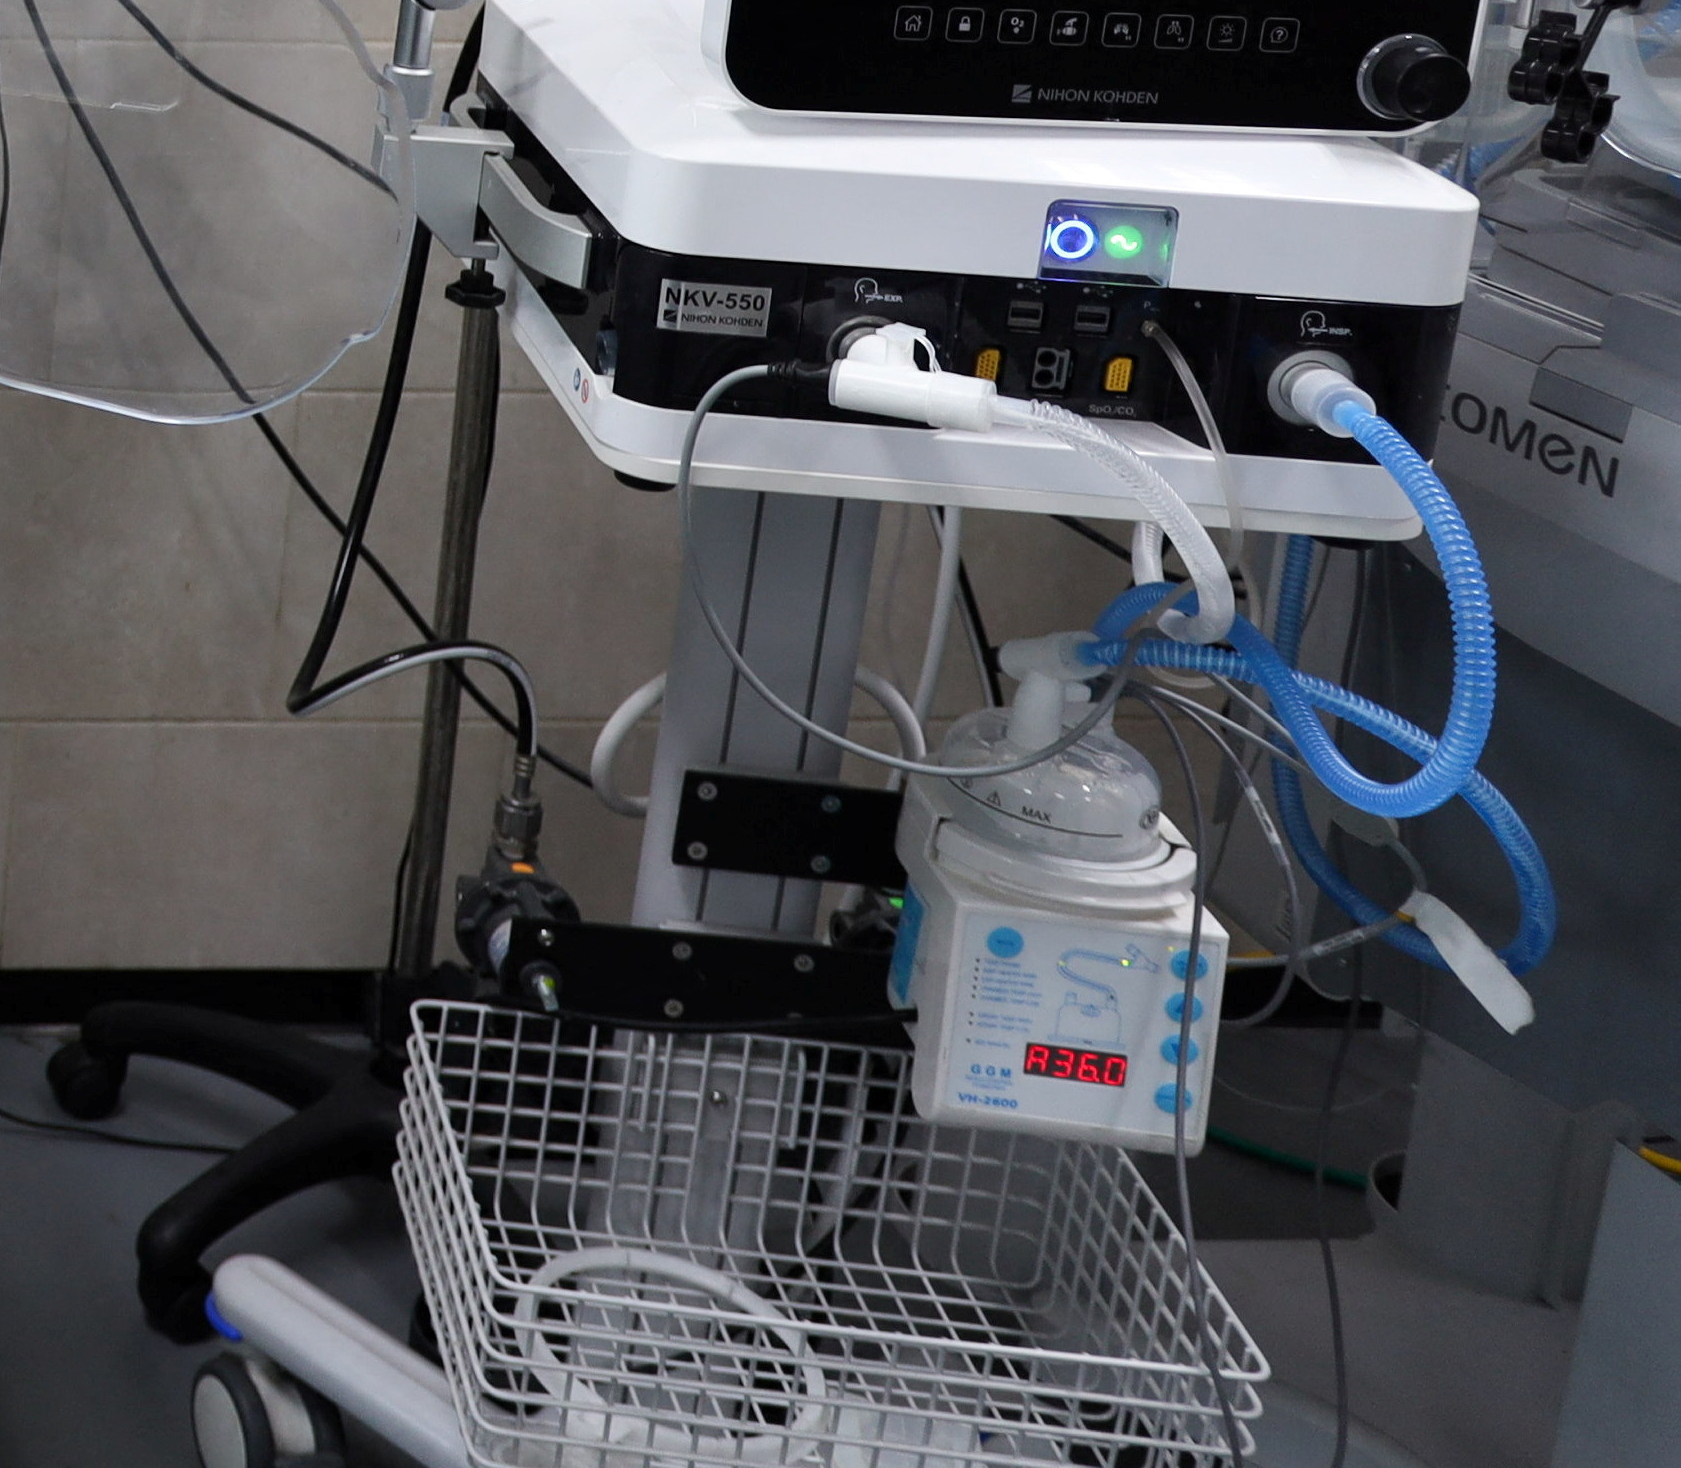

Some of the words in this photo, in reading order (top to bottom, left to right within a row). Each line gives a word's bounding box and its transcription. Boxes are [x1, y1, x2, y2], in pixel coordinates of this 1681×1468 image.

[1038, 89, 1091, 102] NIHON
[1093, 90, 1159, 104] KOHDEN
[665, 287, 766, 312] NKV-550
[682, 311, 716, 325] NIHON
[718, 314, 764, 328] KOHDEN
[1021, 806, 1051, 824] MAX
